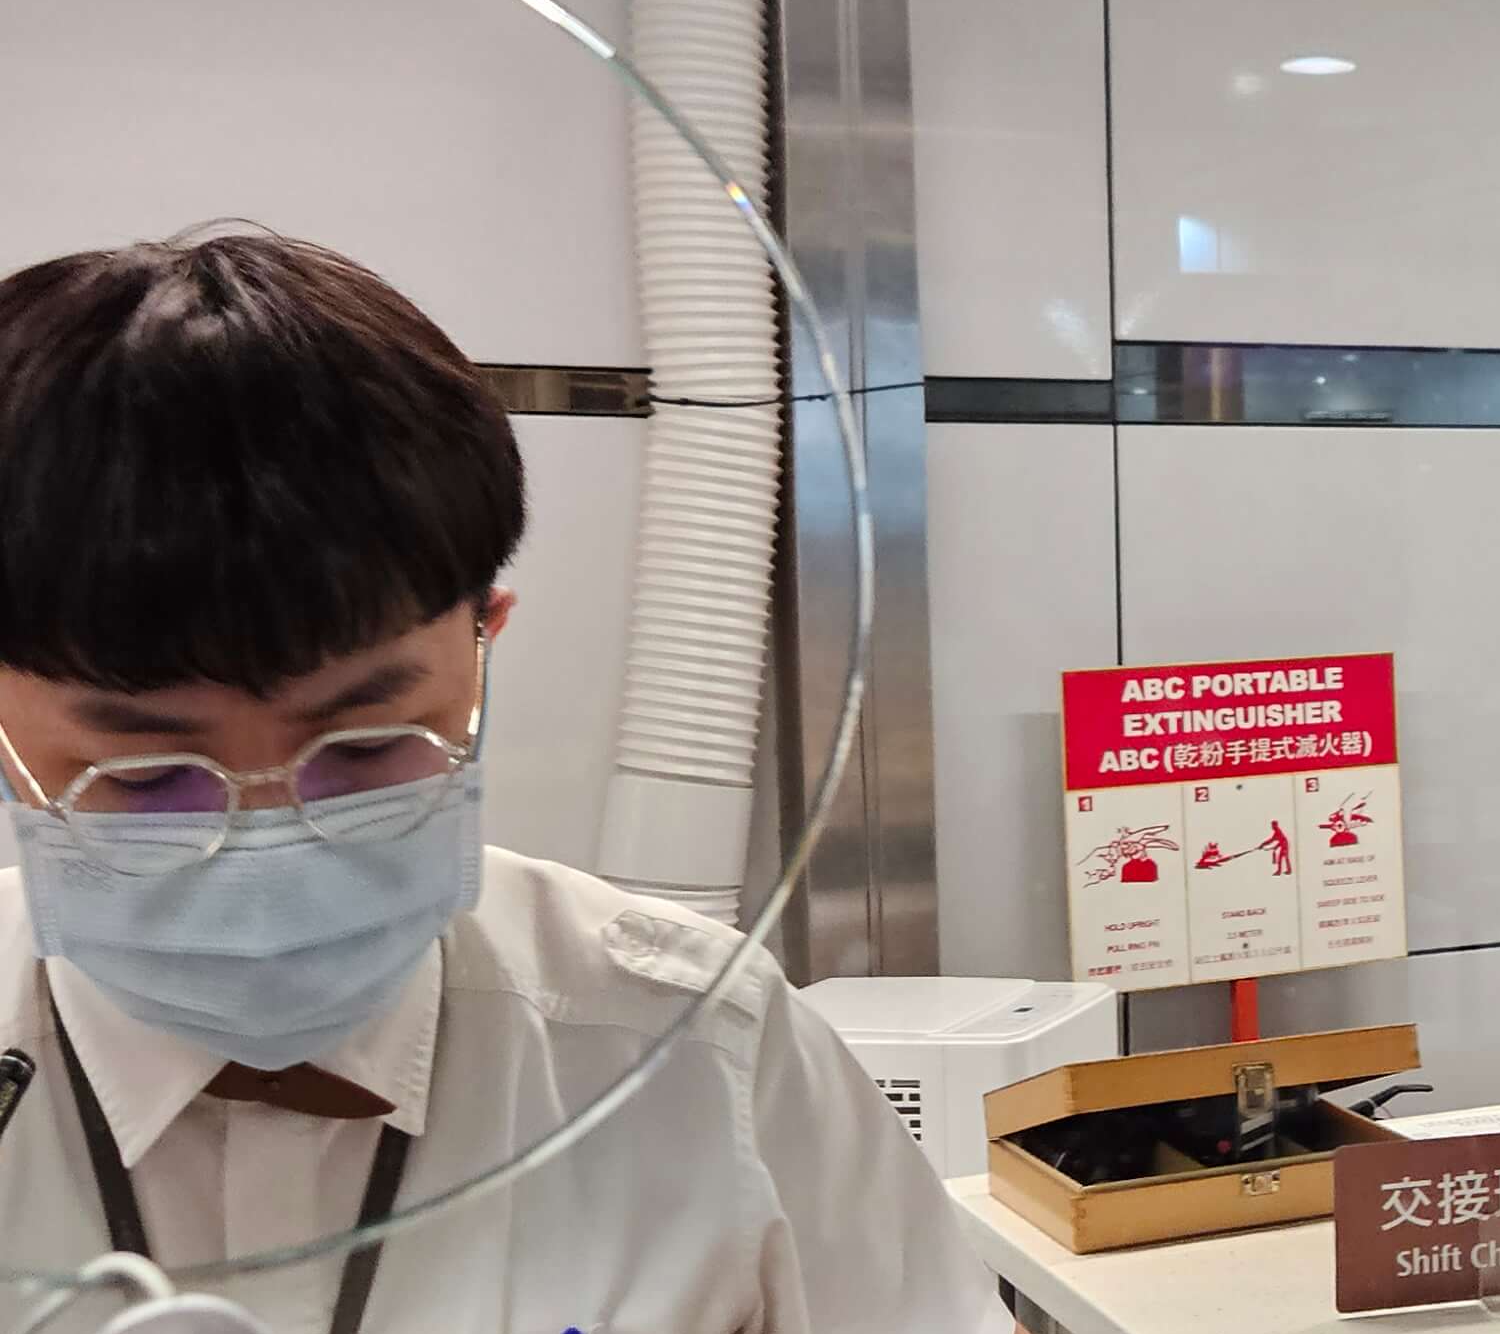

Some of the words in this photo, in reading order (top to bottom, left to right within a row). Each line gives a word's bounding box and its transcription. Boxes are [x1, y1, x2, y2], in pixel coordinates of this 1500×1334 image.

[1121, 676, 1185, 703] ABC
[1191, 666, 1344, 699] PORTABLE
[1122, 700, 1343, 737] EXTINGUISHER
[1098, 747, 1160, 774] ABC
[1396, 1244, 1462, 1277] Shift
